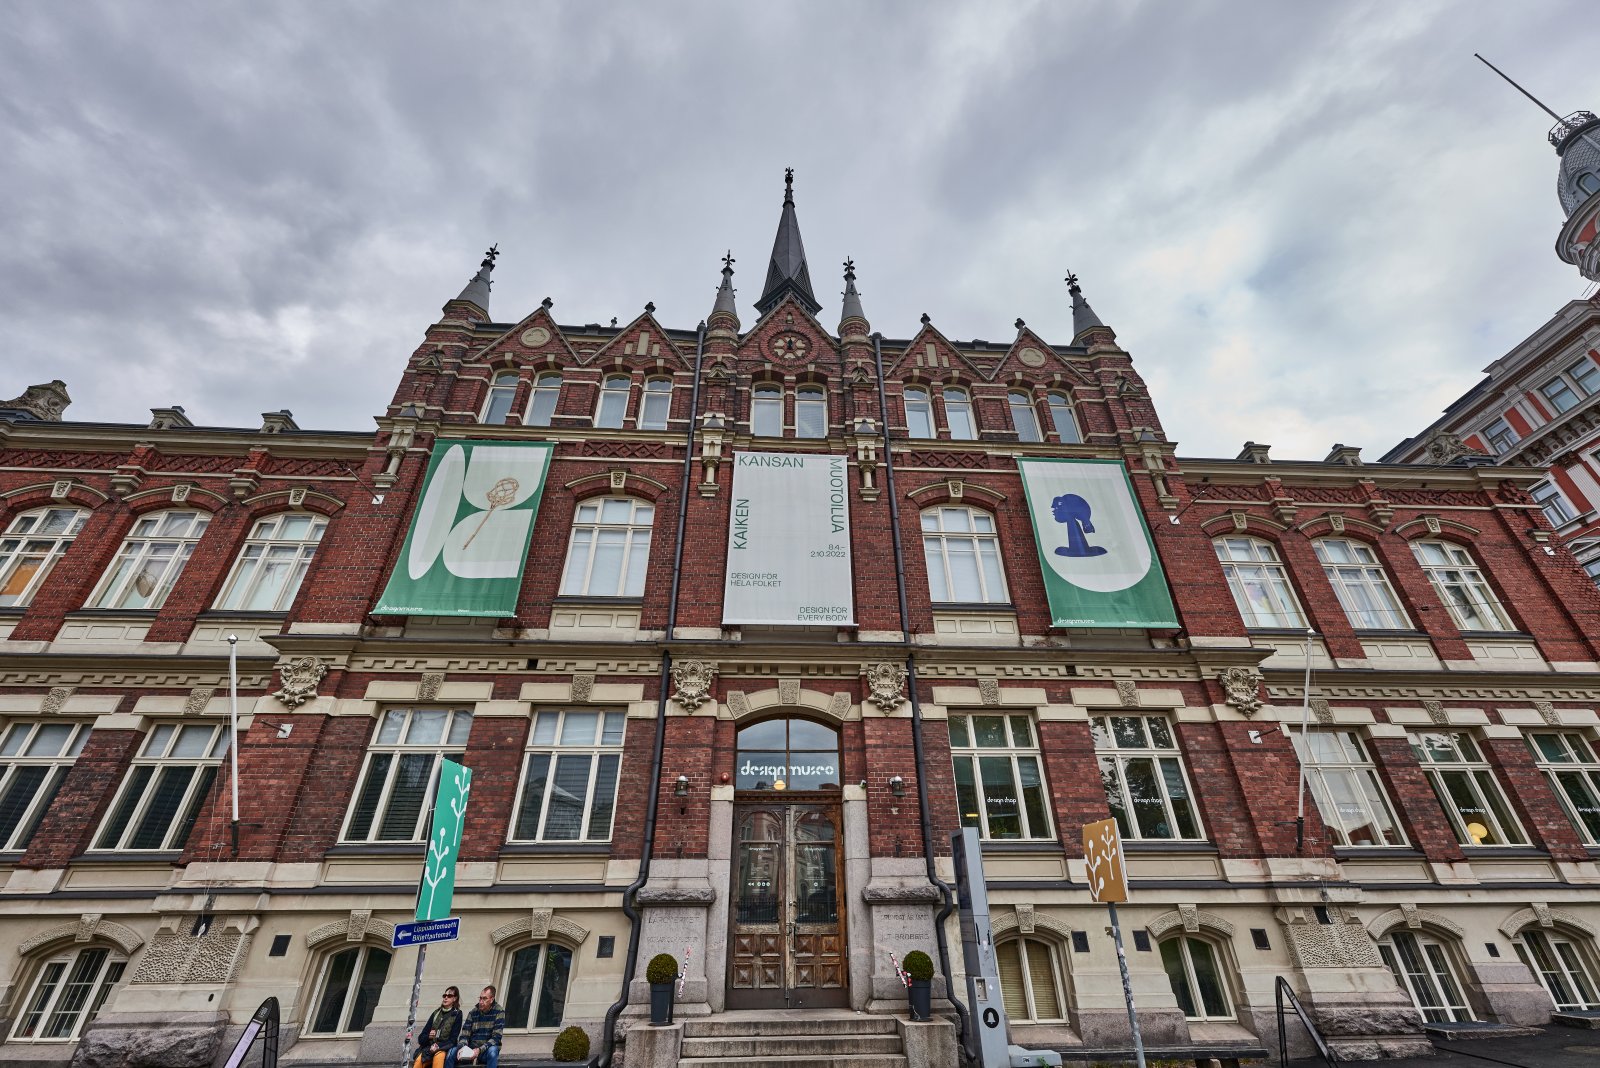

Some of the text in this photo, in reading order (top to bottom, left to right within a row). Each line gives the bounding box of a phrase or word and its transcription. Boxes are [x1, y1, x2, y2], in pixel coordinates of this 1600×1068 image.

[738, 455, 804, 468] KANSAN
[829, 458, 845, 534] MUOTOILUA
[733, 499, 750, 550] KAIKEN
[731, 572, 761, 580] DESIGN
[730, 579, 782, 588] HELA FOLKET
[799, 606, 848, 614] DESIGN FOR
